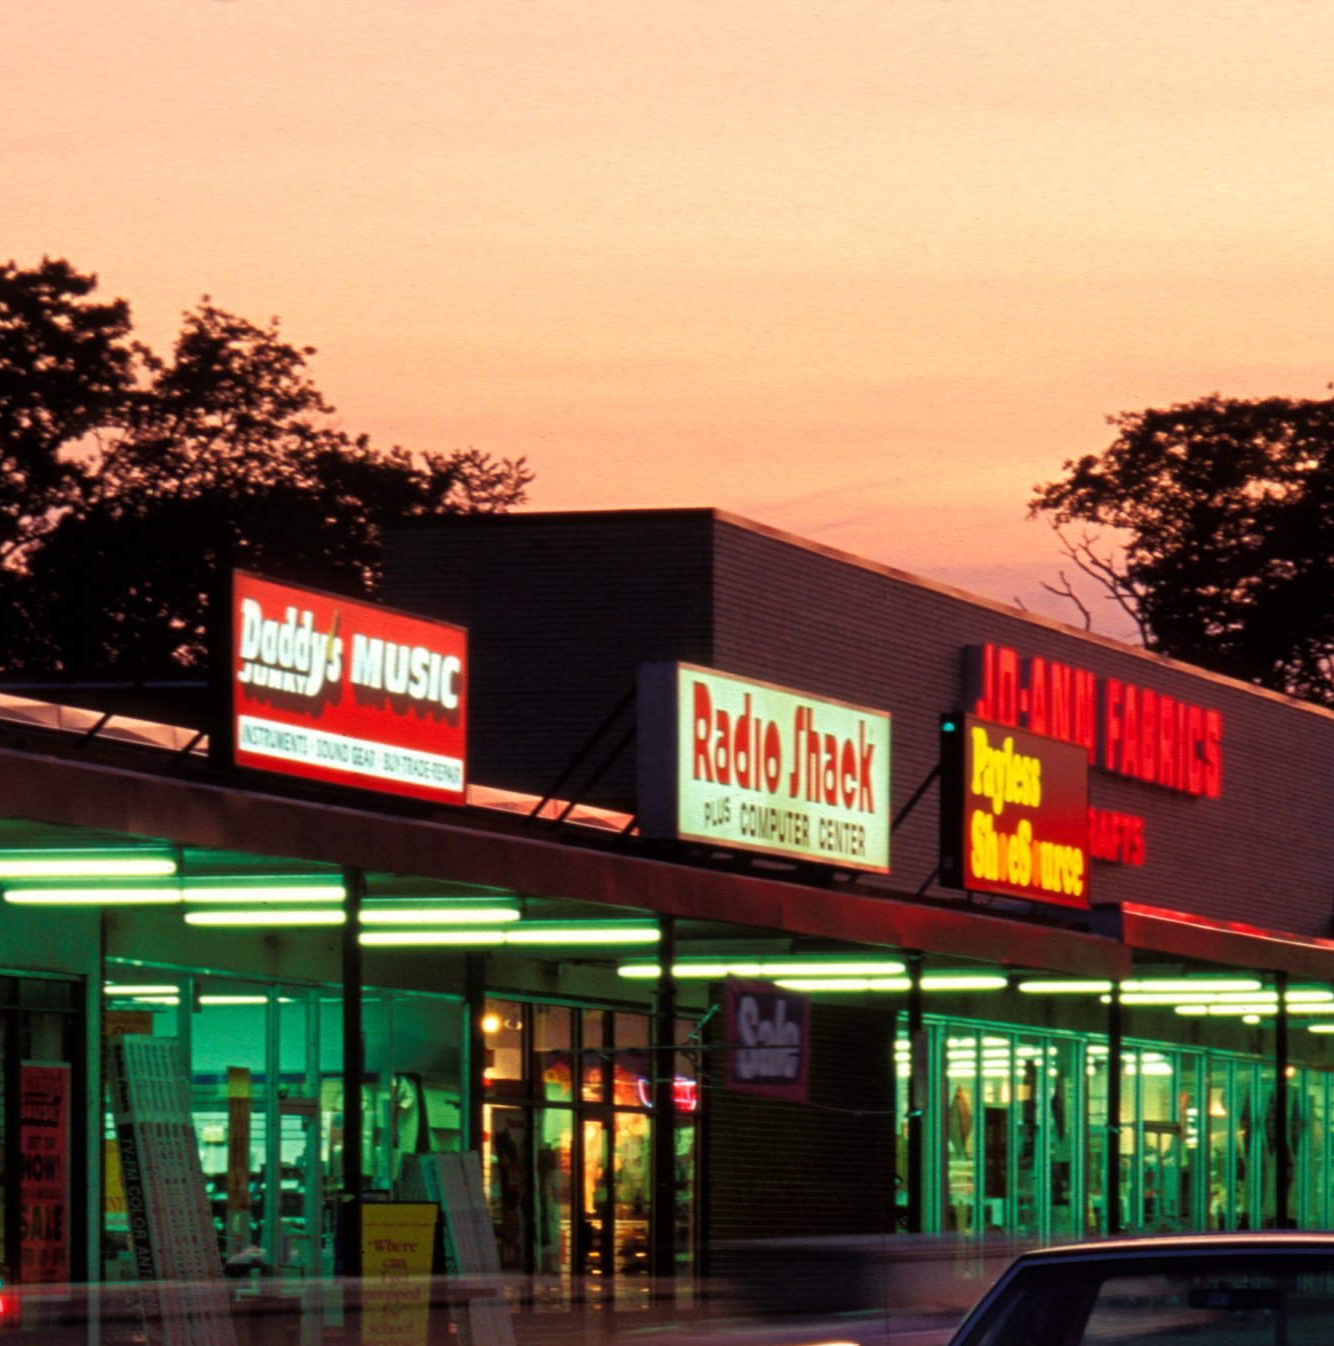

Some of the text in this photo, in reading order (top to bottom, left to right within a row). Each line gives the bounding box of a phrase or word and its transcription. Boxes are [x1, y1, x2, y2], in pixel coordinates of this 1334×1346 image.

[240, 597, 461, 709] Daddy's MUSIC
[692, 680, 876, 815] Radio Shack
[970, 726, 1043, 816] Payless
[975, 642, 1223, 800] JO-ANN FABRICS
[704, 797, 867, 857] PLUS COMPUTER CENTER
[120, 1136, 159, 1318] TV-FM COLOR ANTENNA
[383, 1258, 408, 1269] can
[369, 1320, 413, 1334] school
